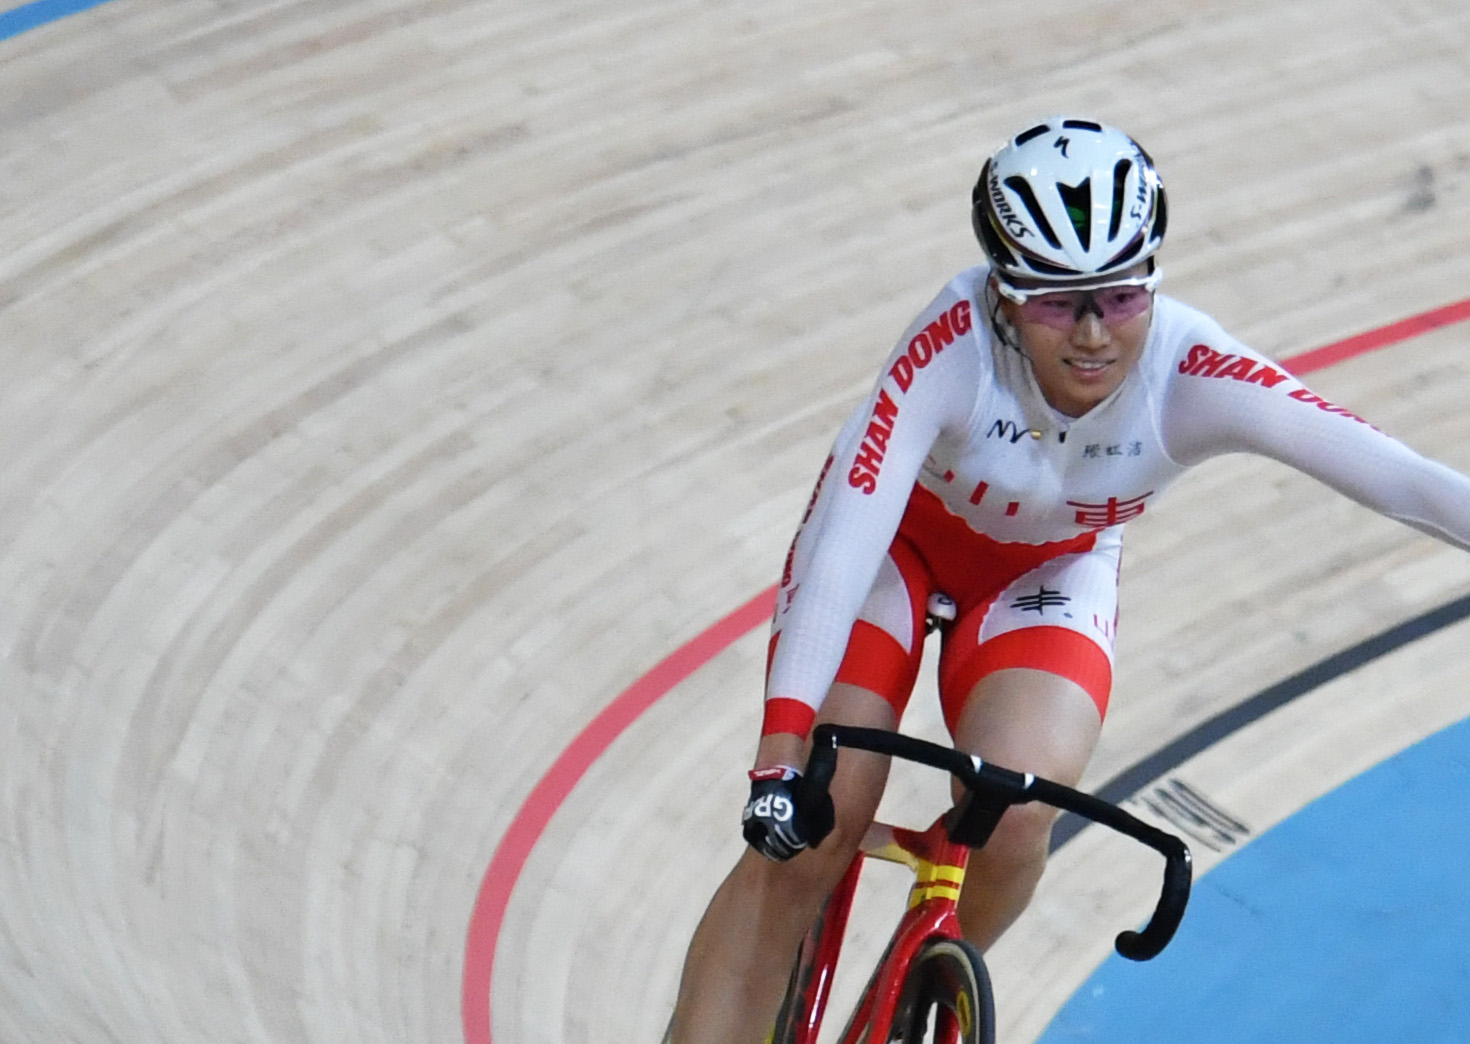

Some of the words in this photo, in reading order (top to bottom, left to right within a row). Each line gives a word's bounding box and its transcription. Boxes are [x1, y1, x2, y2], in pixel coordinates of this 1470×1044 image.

[848, 386, 899, 495] SHAN
[888, 299, 972, 394] DONG
[1178, 344, 1290, 388] SHAN
